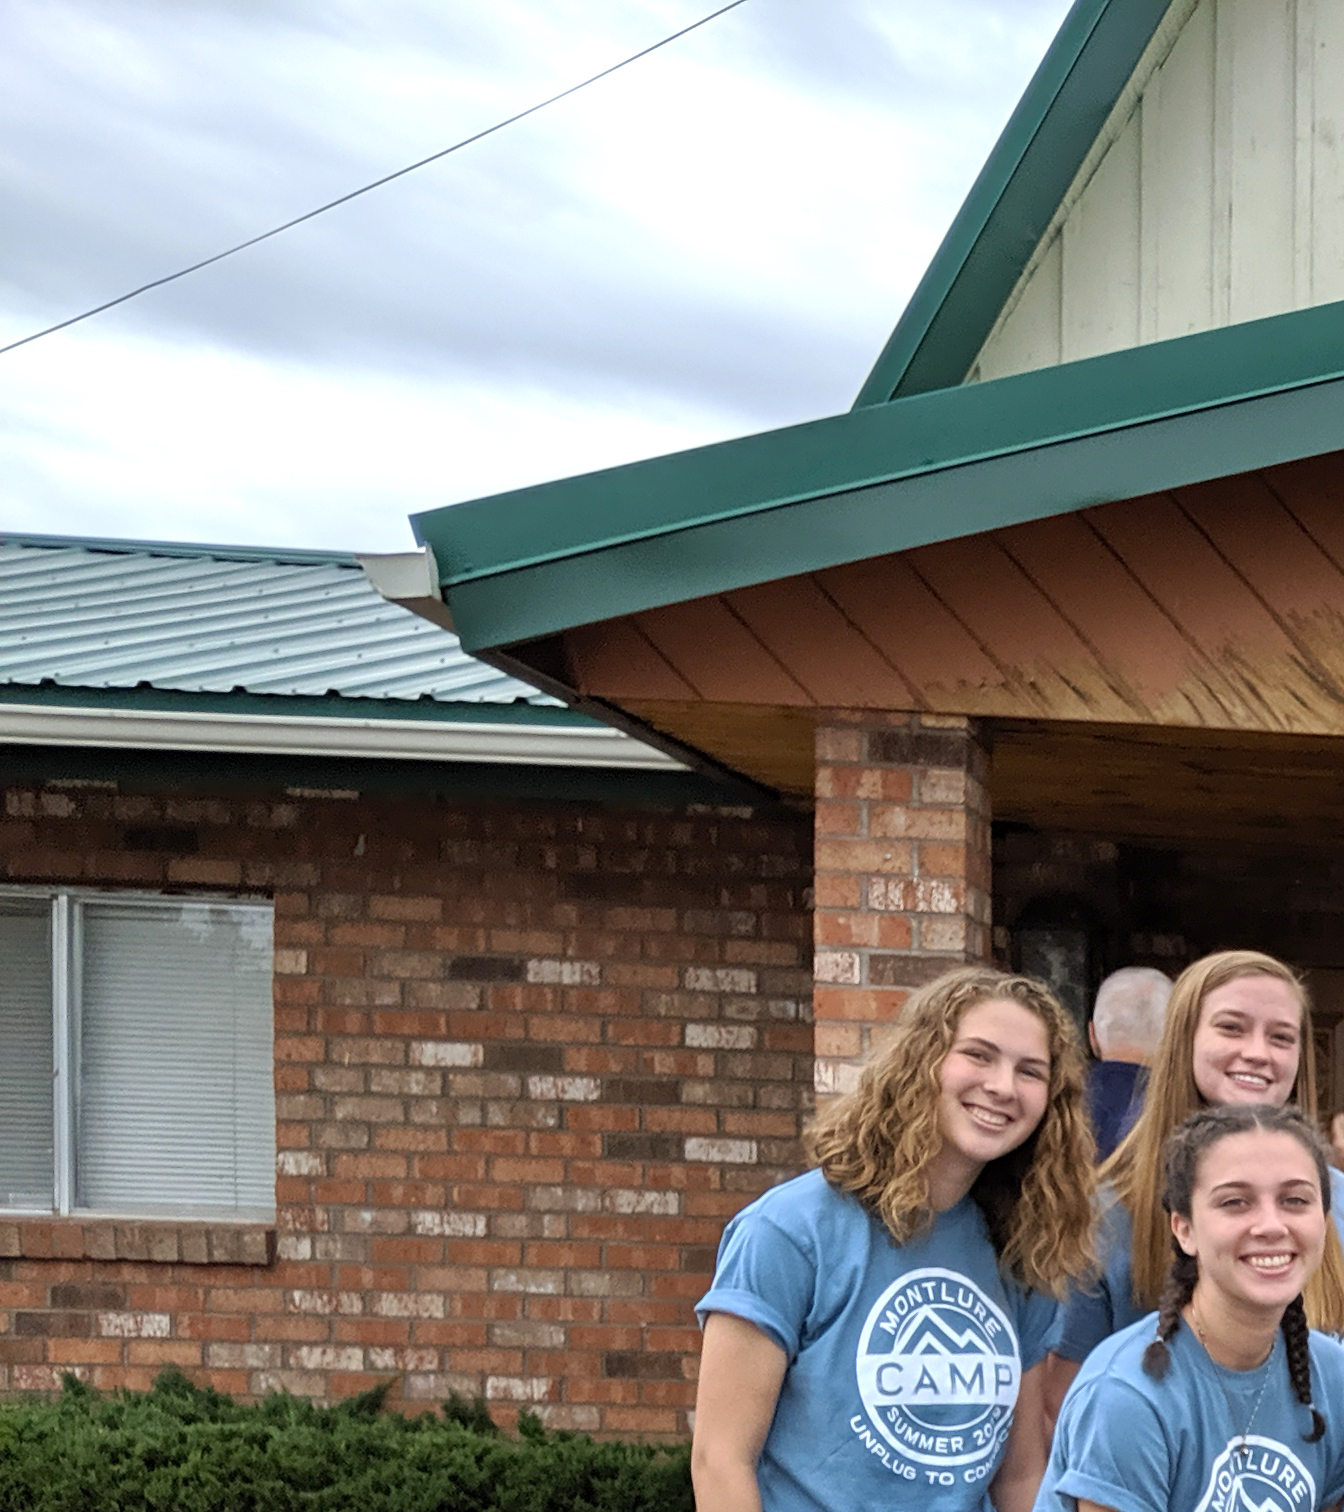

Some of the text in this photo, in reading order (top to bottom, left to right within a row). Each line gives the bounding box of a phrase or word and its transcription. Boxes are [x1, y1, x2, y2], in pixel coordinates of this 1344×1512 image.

[879, 1281, 1002, 1338] MONTLURE
[876, 1362, 1013, 1396] CAMP
[850, 1414, 917, 1481] UNPLUG
[925, 1471, 955, 1486] TO
[887, 1407, 964, 1453] SUMMER
